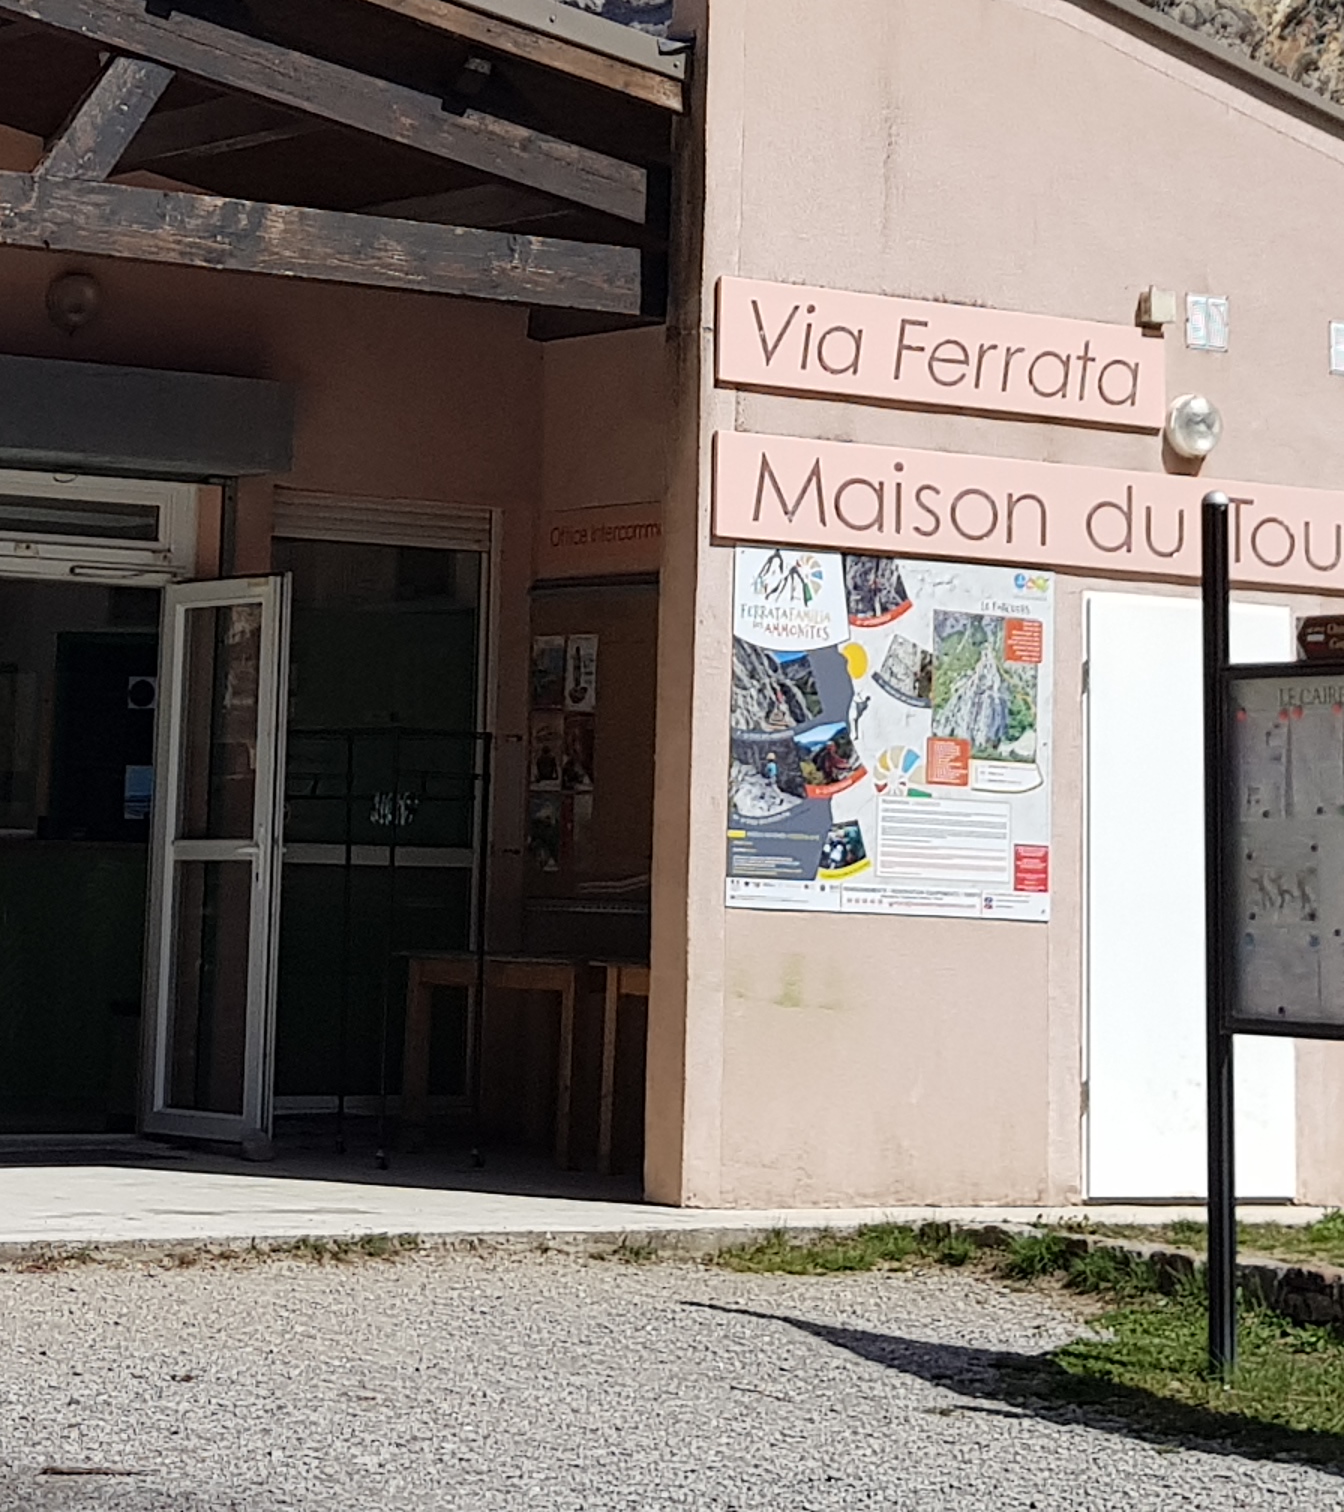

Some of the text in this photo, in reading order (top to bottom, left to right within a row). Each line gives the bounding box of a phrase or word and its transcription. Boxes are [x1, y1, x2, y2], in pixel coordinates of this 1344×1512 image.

[751, 299, 1140, 407] Via Ferrata
[752, 451, 1048, 547] Maison
[1085, 485, 1185, 558] du
